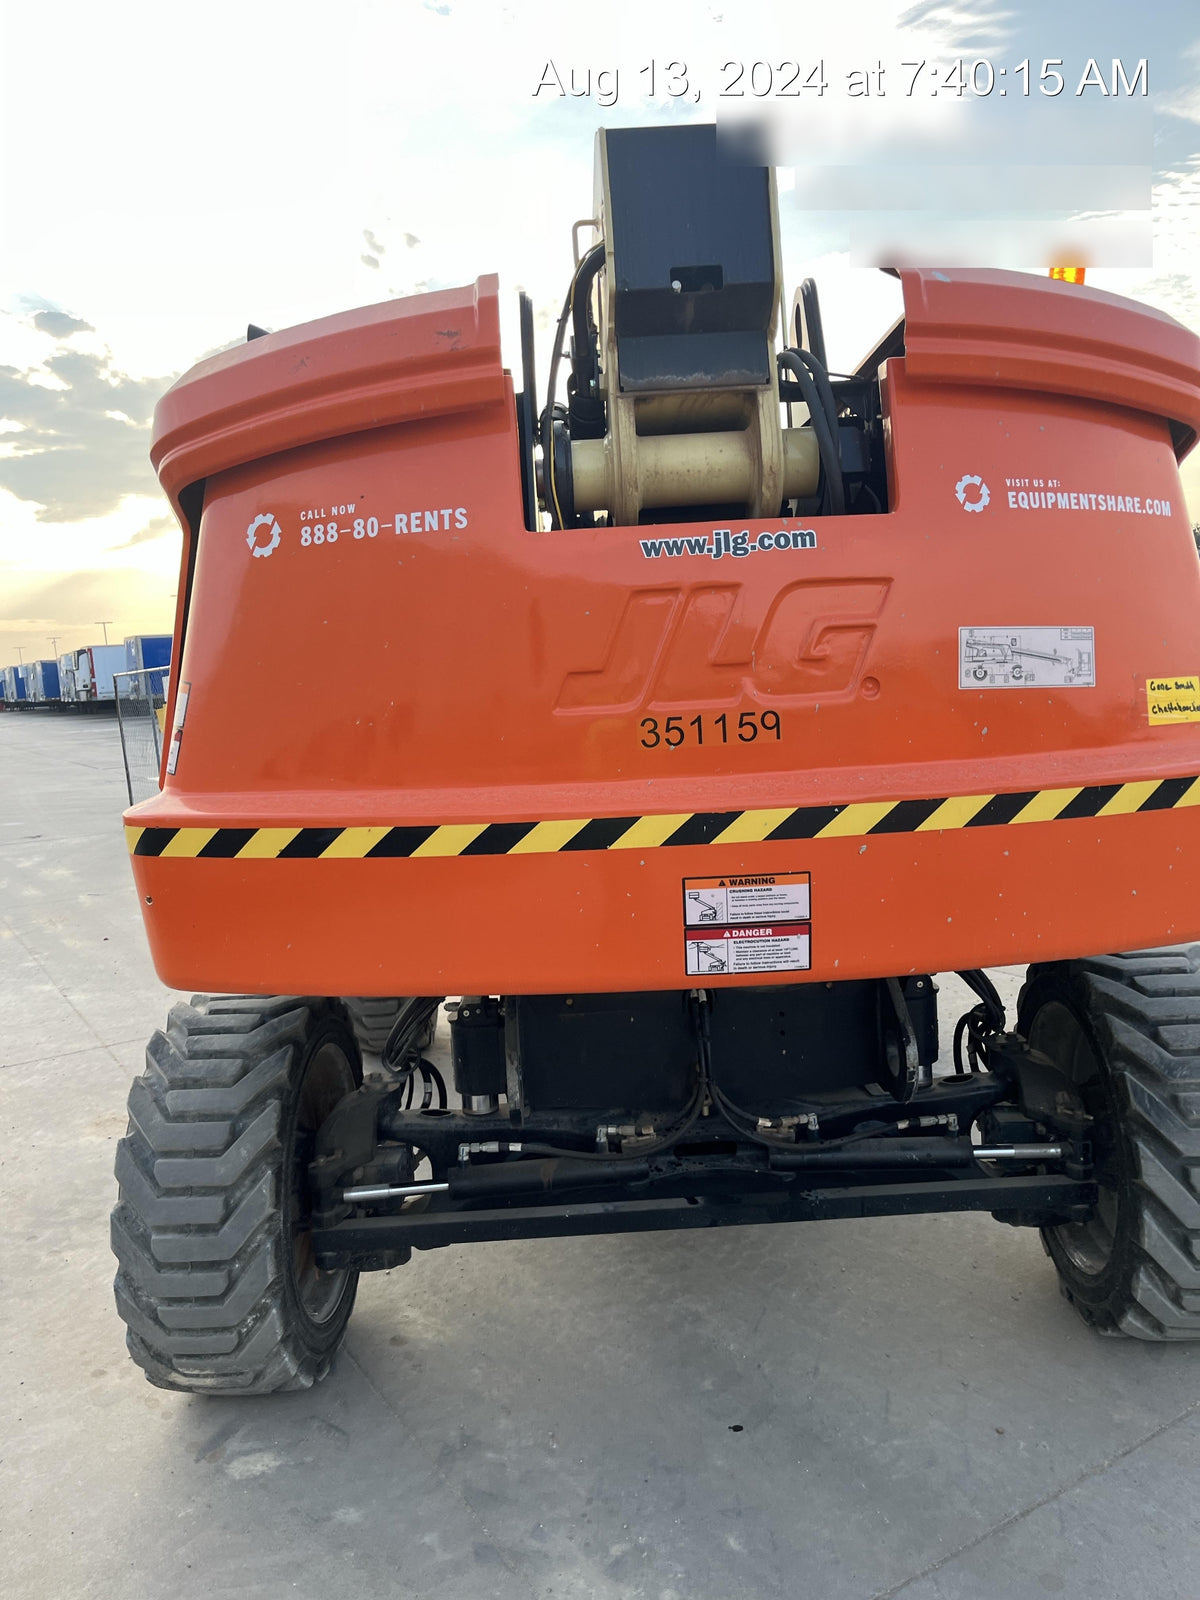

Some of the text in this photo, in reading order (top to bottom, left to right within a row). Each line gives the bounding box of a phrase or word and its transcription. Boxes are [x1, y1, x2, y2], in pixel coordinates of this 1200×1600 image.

[1005, 478, 1030, 487] VISIT
[1033, 478, 1044, 487] US
[300, 503, 356, 521] CALL NOW
[1007, 491, 1172, 517] EQUIPMENTSHARE.COM
[300, 507, 468, 547] 888-80-RENTS
[640, 529, 817, 559] www.jlg.com
[552, 576, 895, 716] JLG
[640, 710, 782, 748] 351159
[729, 877, 776, 886] WARNING
[732, 928, 773, 938] DANGER
